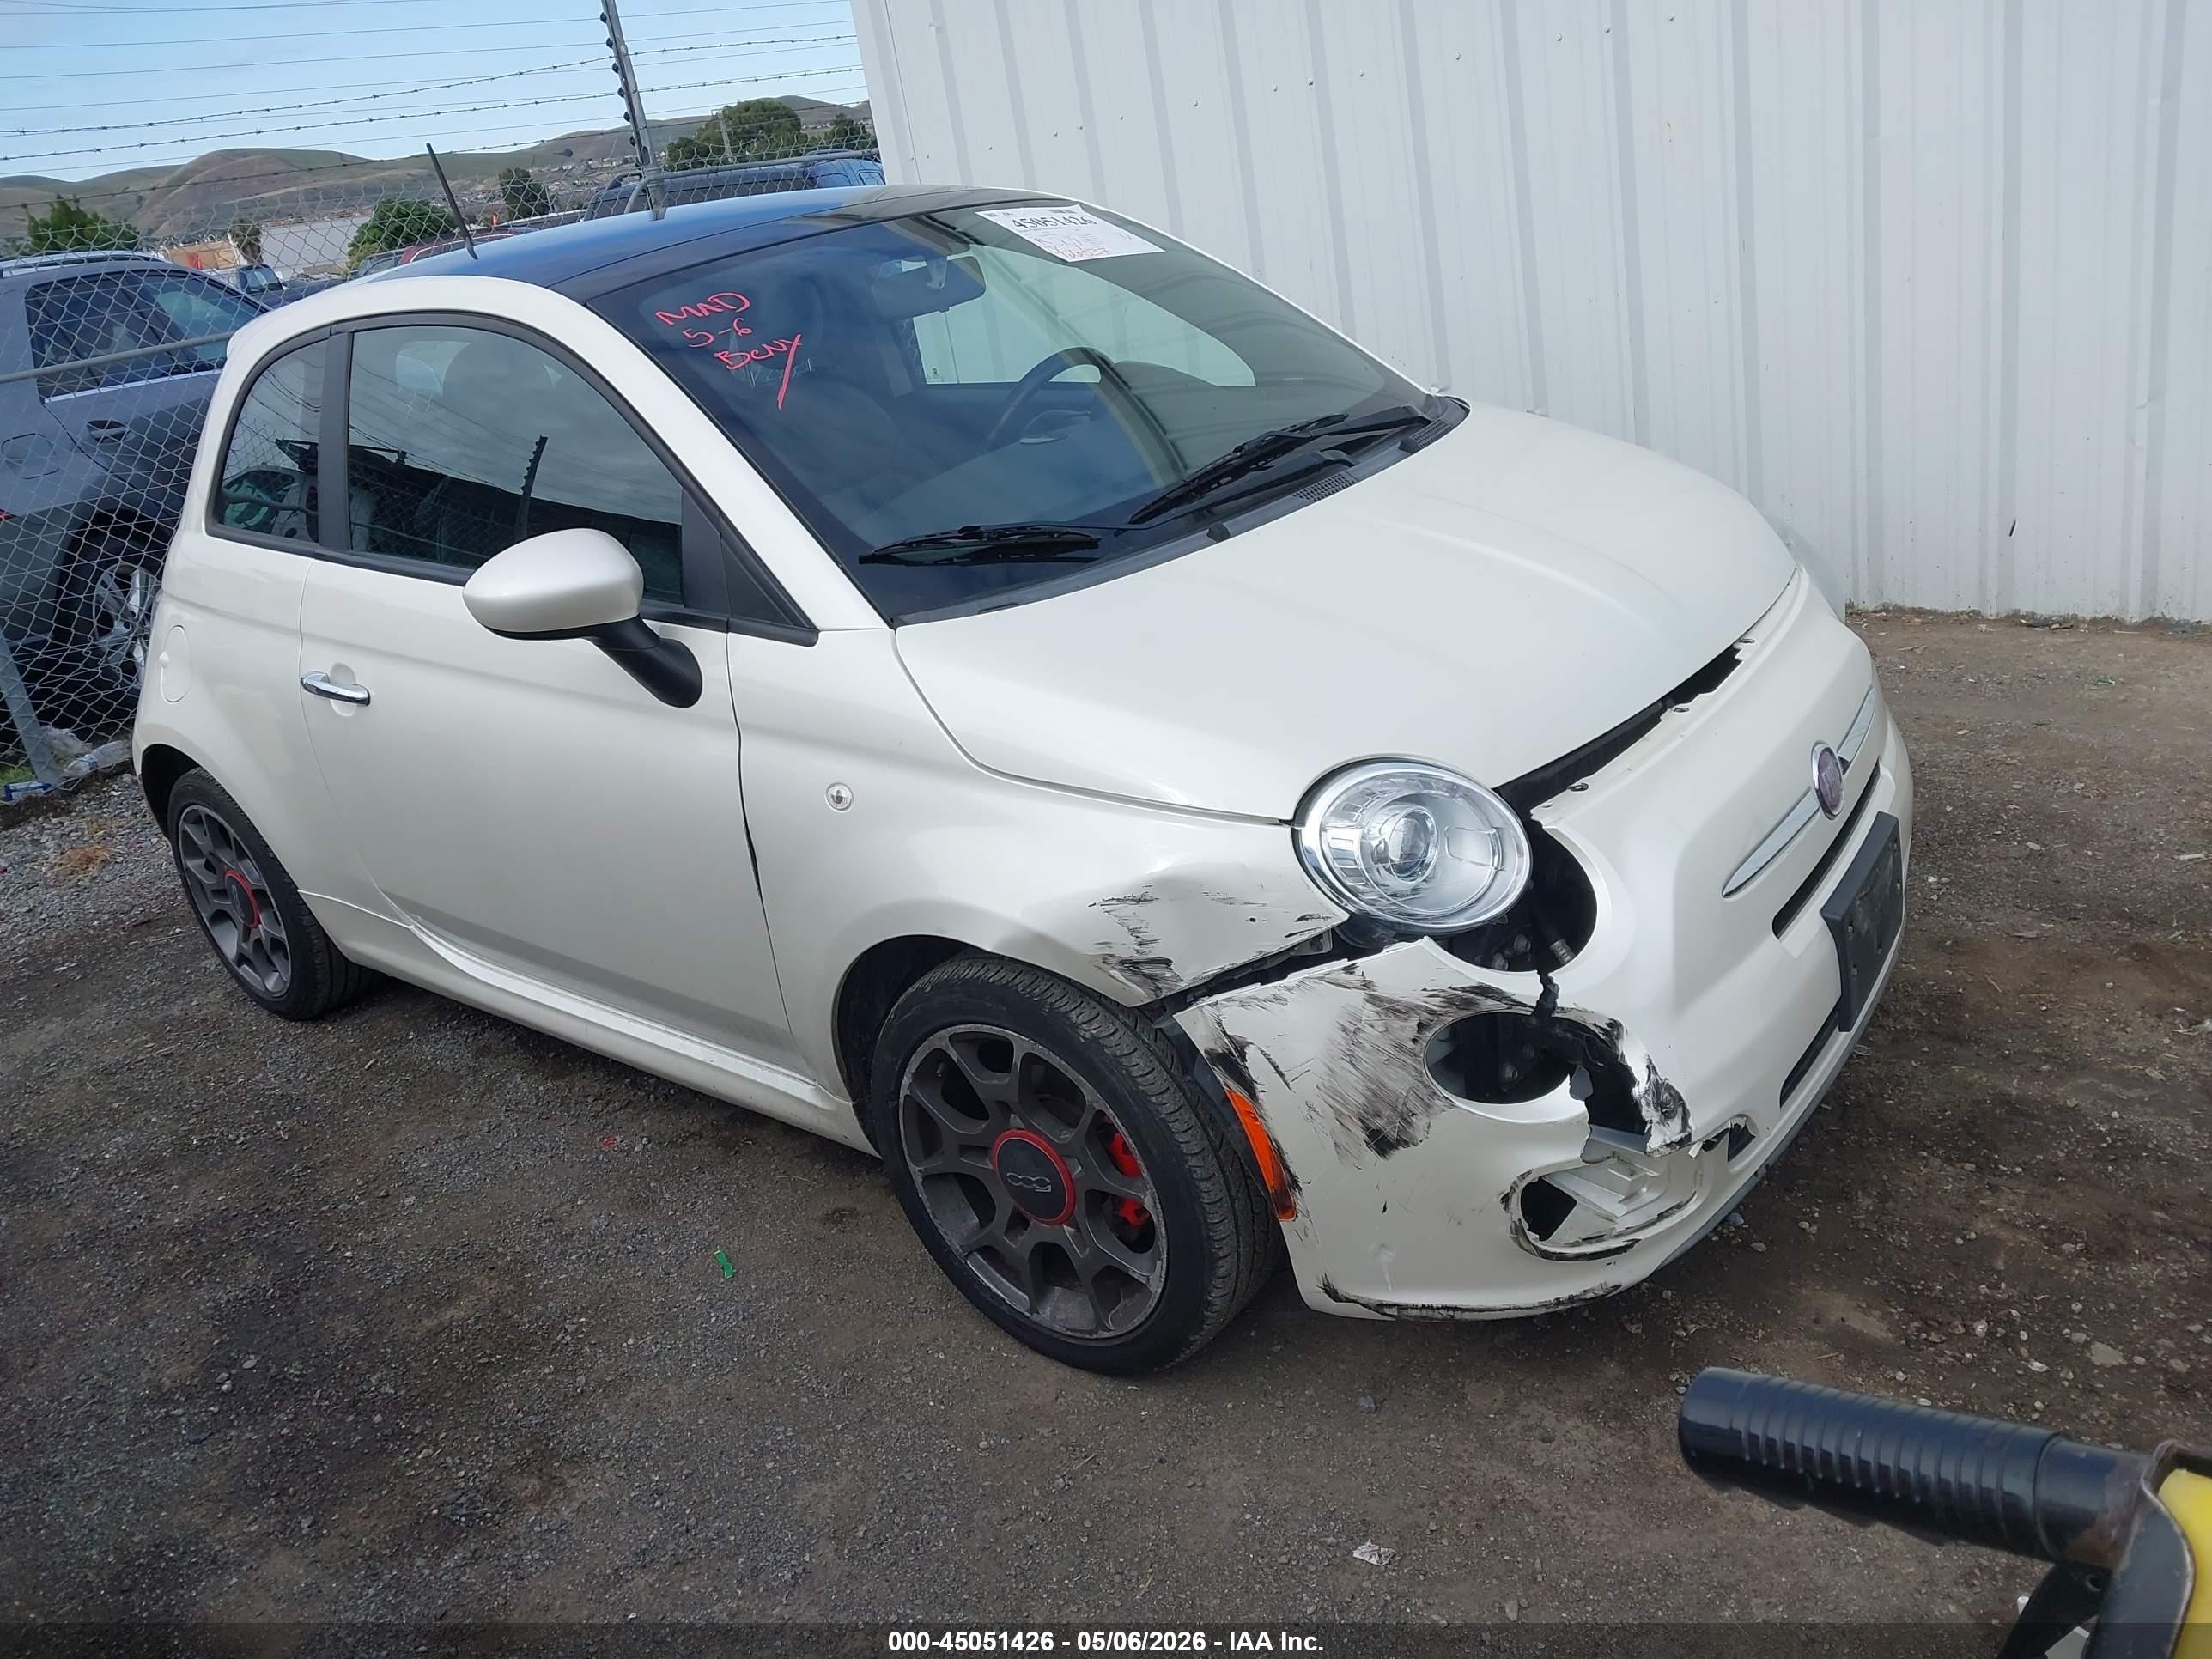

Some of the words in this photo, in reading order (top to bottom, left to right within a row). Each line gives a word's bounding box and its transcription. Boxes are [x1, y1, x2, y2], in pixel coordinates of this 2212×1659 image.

[1012, 216, 1097, 228] 45051426
[655, 291, 751, 325] MAD
[682, 317, 752, 348] 5-6
